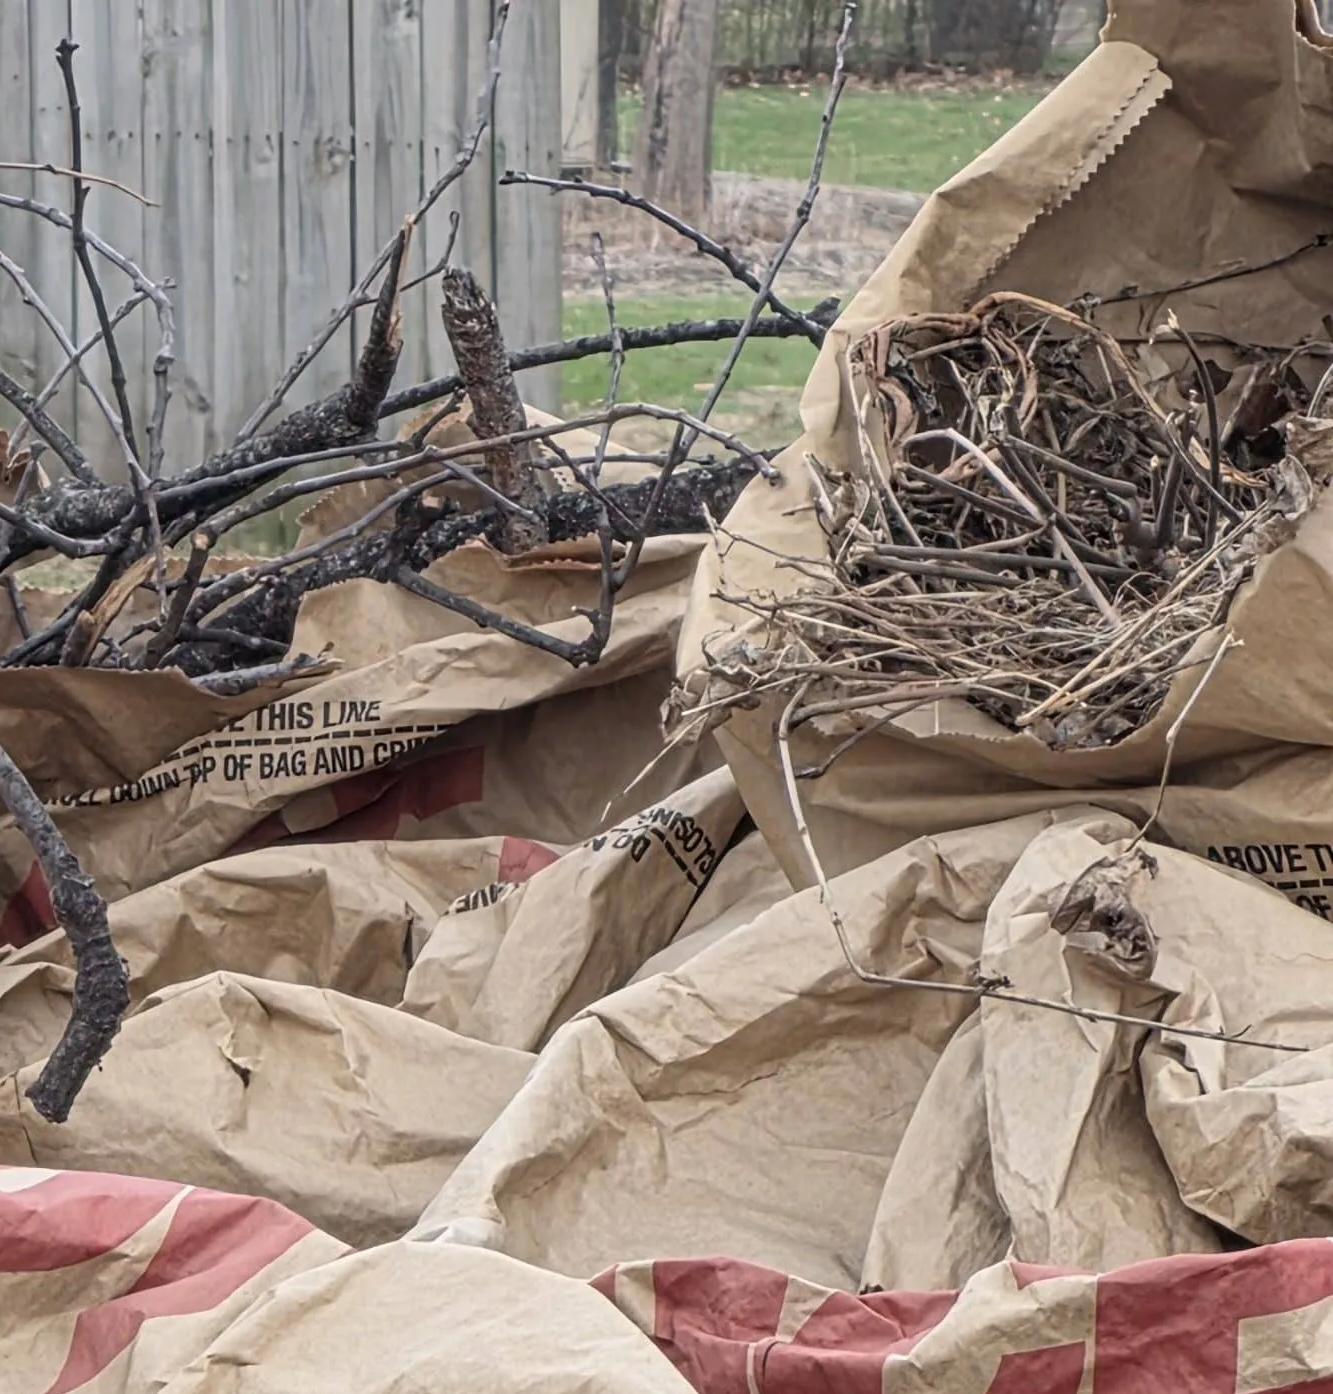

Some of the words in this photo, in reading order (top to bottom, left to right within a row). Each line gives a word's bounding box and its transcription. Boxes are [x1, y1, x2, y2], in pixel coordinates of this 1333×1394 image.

[254, 701, 315, 732] THIS
[322, 699, 383, 729] LINE
[223, 753, 254, 782] OF
[258, 751, 308, 780] BAG
[313, 745, 366, 776] AND
